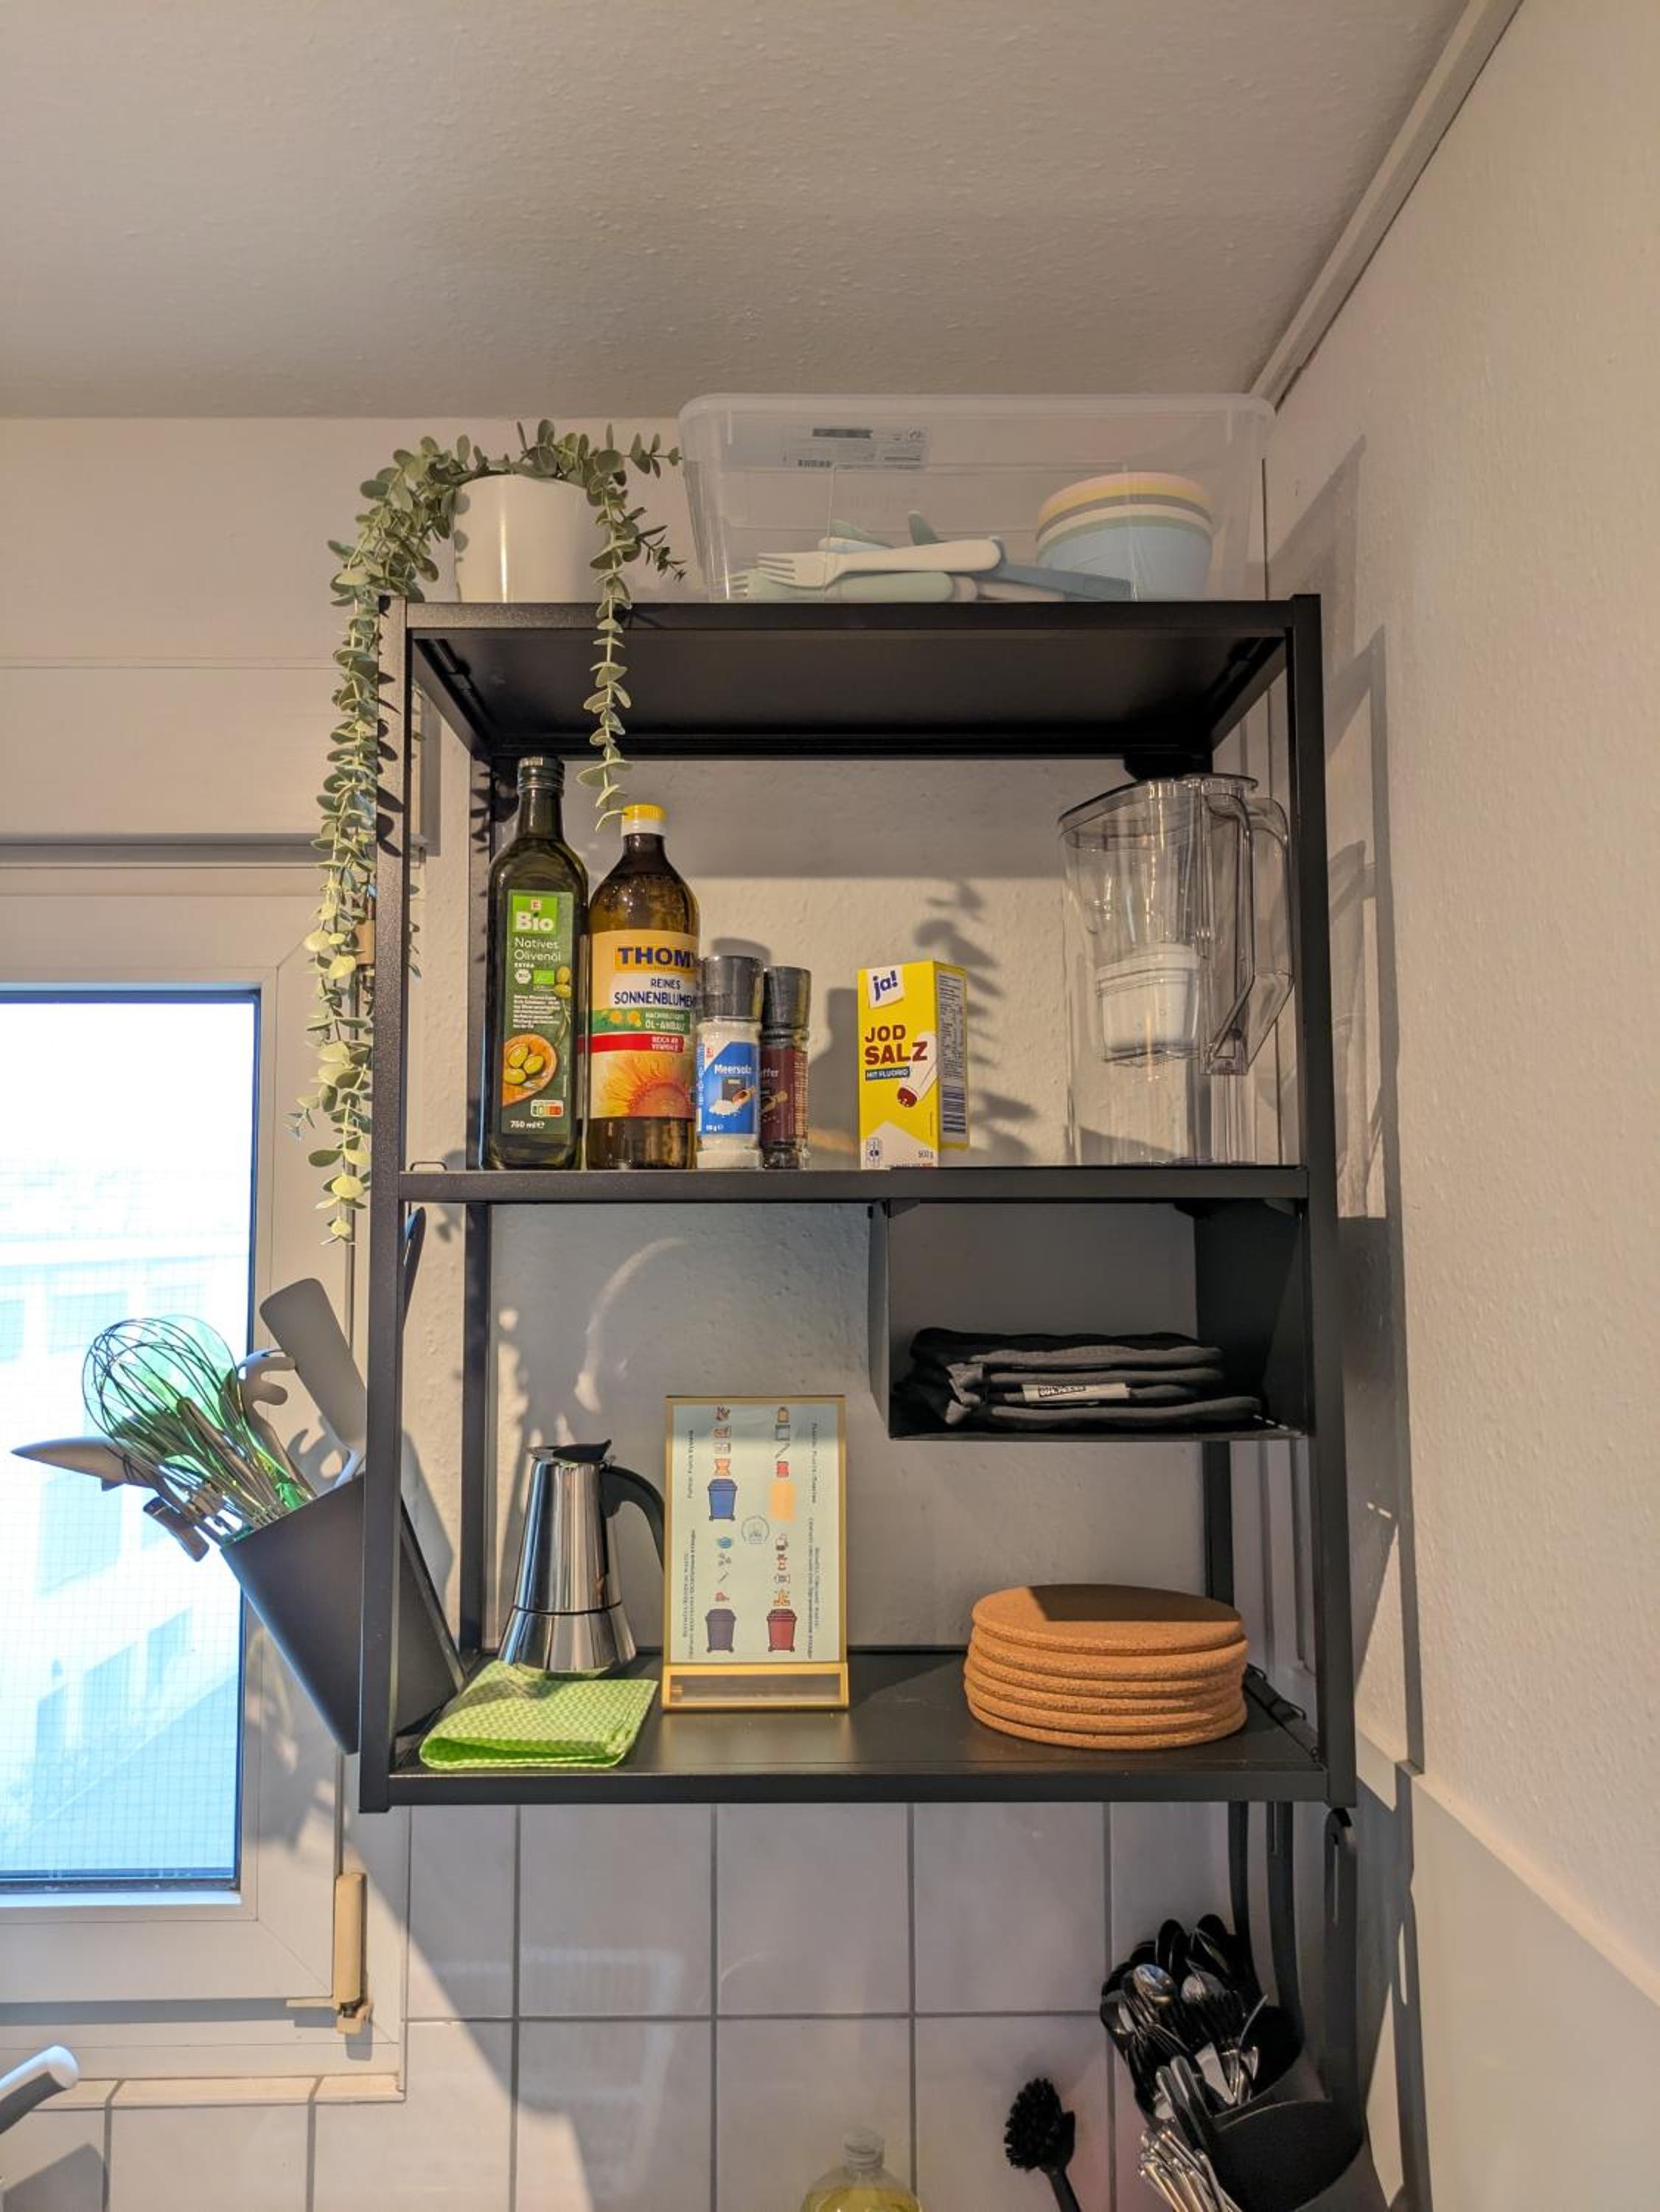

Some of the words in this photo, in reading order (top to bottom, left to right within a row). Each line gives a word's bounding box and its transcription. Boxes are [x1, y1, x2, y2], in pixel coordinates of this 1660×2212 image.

[516, 911, 554, 931] Bio
[515, 937, 559, 949] Natives
[515, 949, 561, 961] Olivenöl
[650, 978, 680, 990] REINES
[872, 970, 898, 1001] ja!
[865, 1024, 906, 1043] JOD
[865, 1041, 928, 1065] SALZ
[510, 1120, 525, 1128] 750
